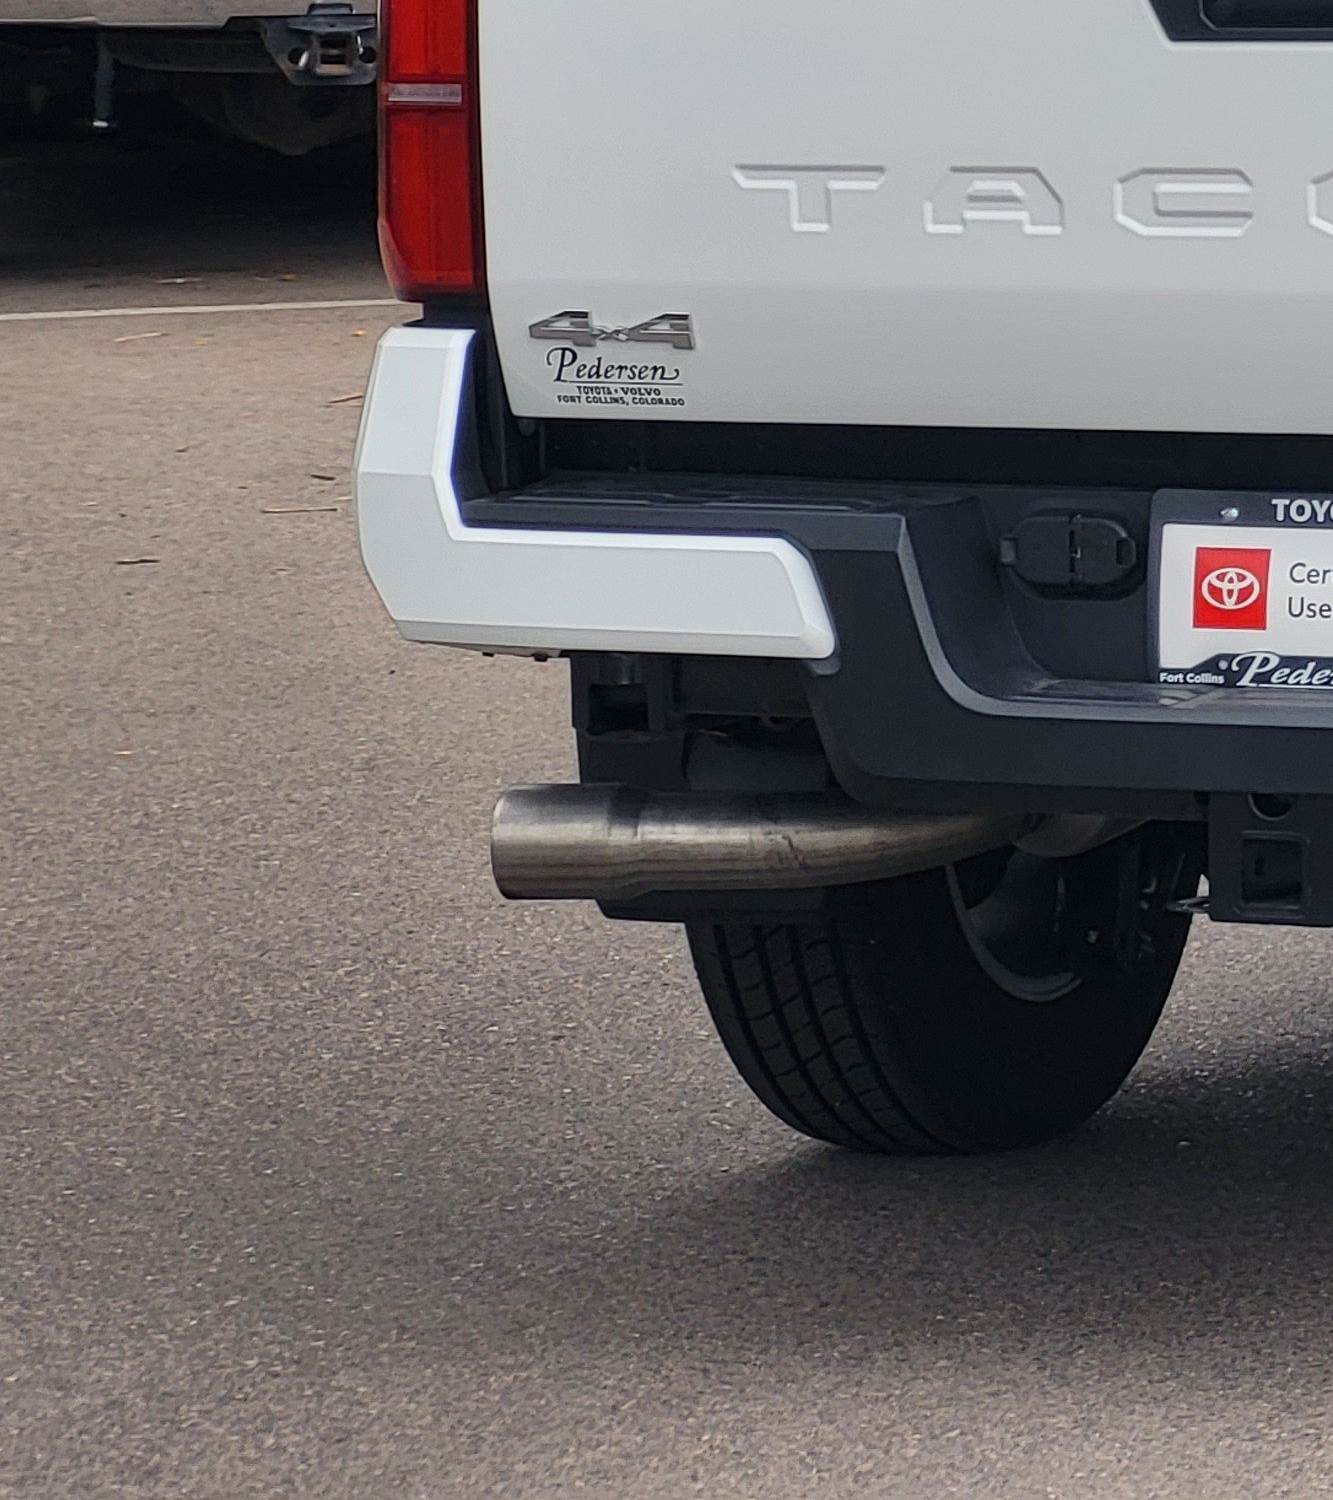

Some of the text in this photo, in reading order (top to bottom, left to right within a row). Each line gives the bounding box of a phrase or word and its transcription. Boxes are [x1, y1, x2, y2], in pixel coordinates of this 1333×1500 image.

[546, 346, 682, 384] Pedersen
[576, 385, 661, 396] TOYOTA VOLVO
[557, 395, 582, 404] FORT
[632, 396, 685, 406] COLORADO
[1159, 671, 1226, 685] Fort Collins
